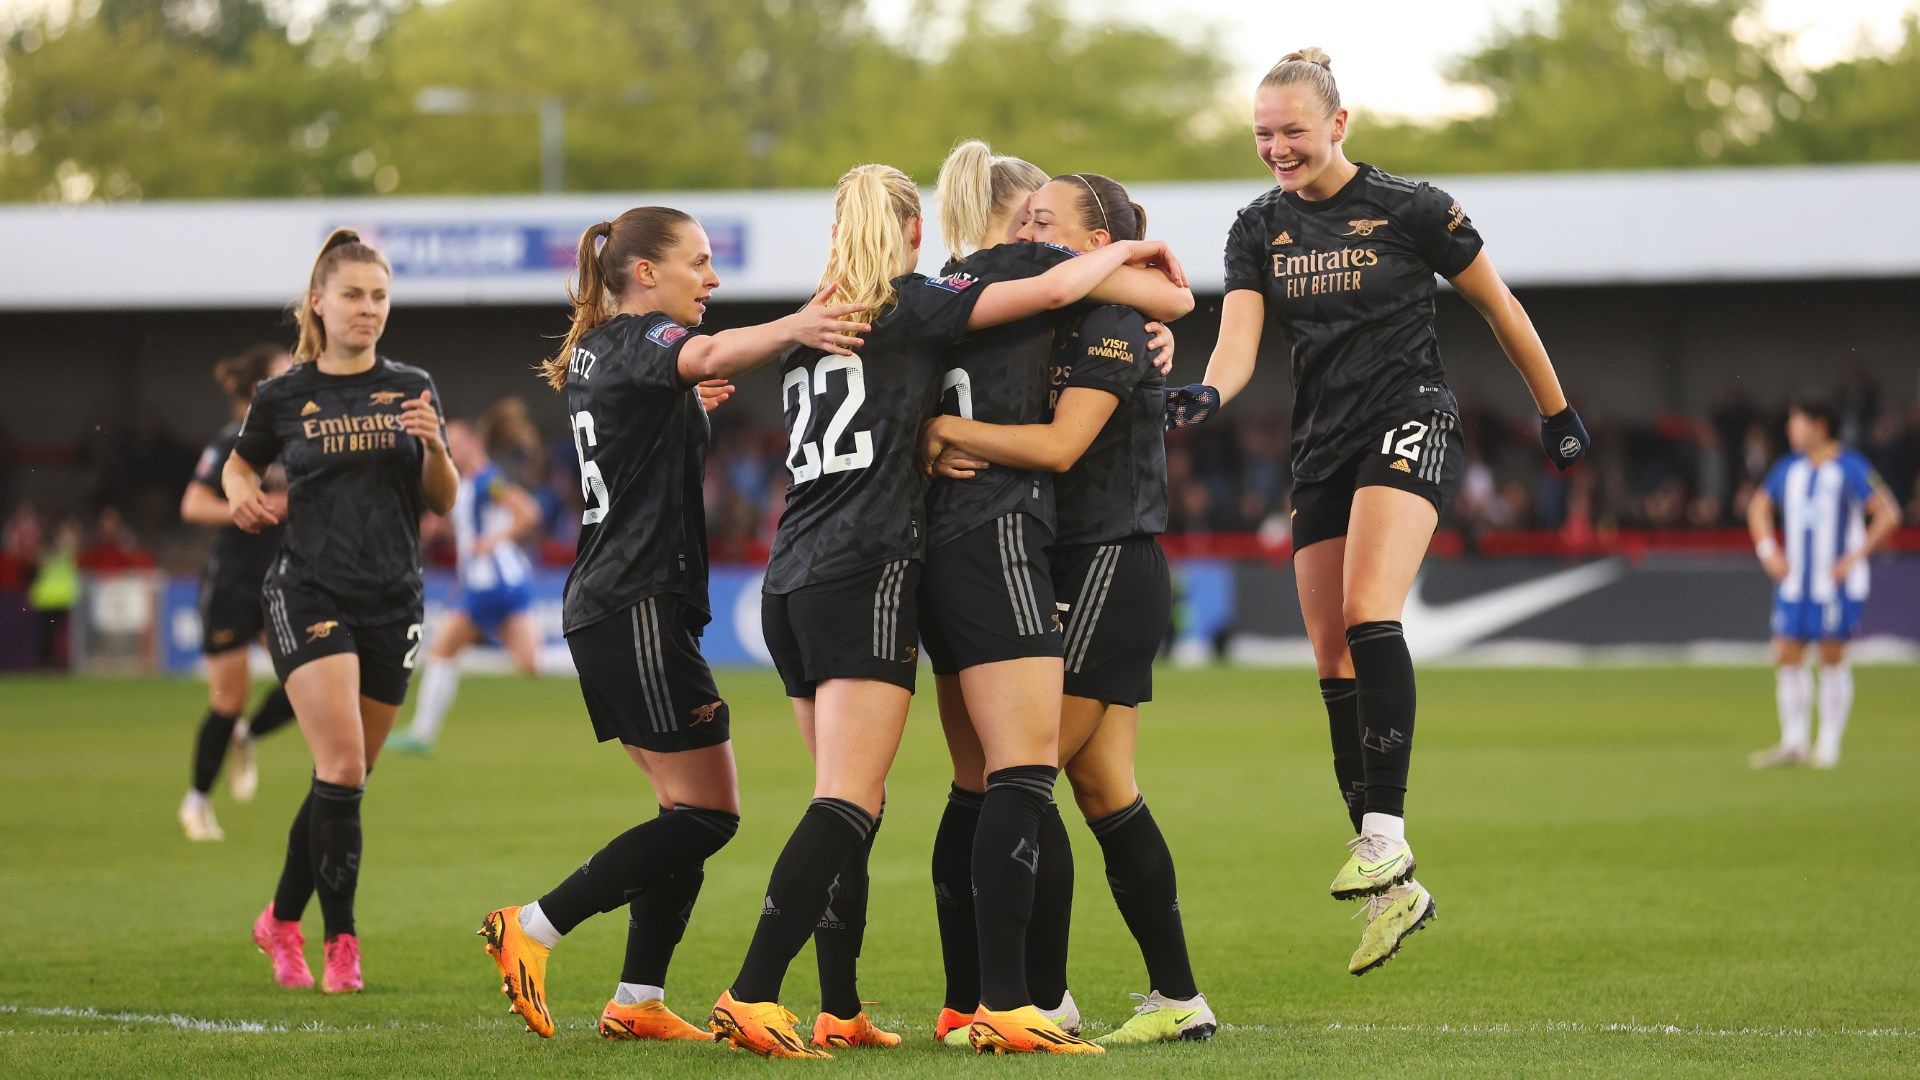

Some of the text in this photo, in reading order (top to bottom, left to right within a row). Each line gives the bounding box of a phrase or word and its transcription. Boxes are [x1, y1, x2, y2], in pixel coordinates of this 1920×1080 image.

[1272, 246, 1378, 278] Emirates
[1287, 271, 1361, 299] FLY BETTER
[1087, 346, 1134, 364] RWANDA
[1101, 337, 1129, 351] VISIT
[782, 353, 874, 485] 22
[323, 431, 396, 455] FLY BETTER
[1381, 420, 1429, 462] 12
